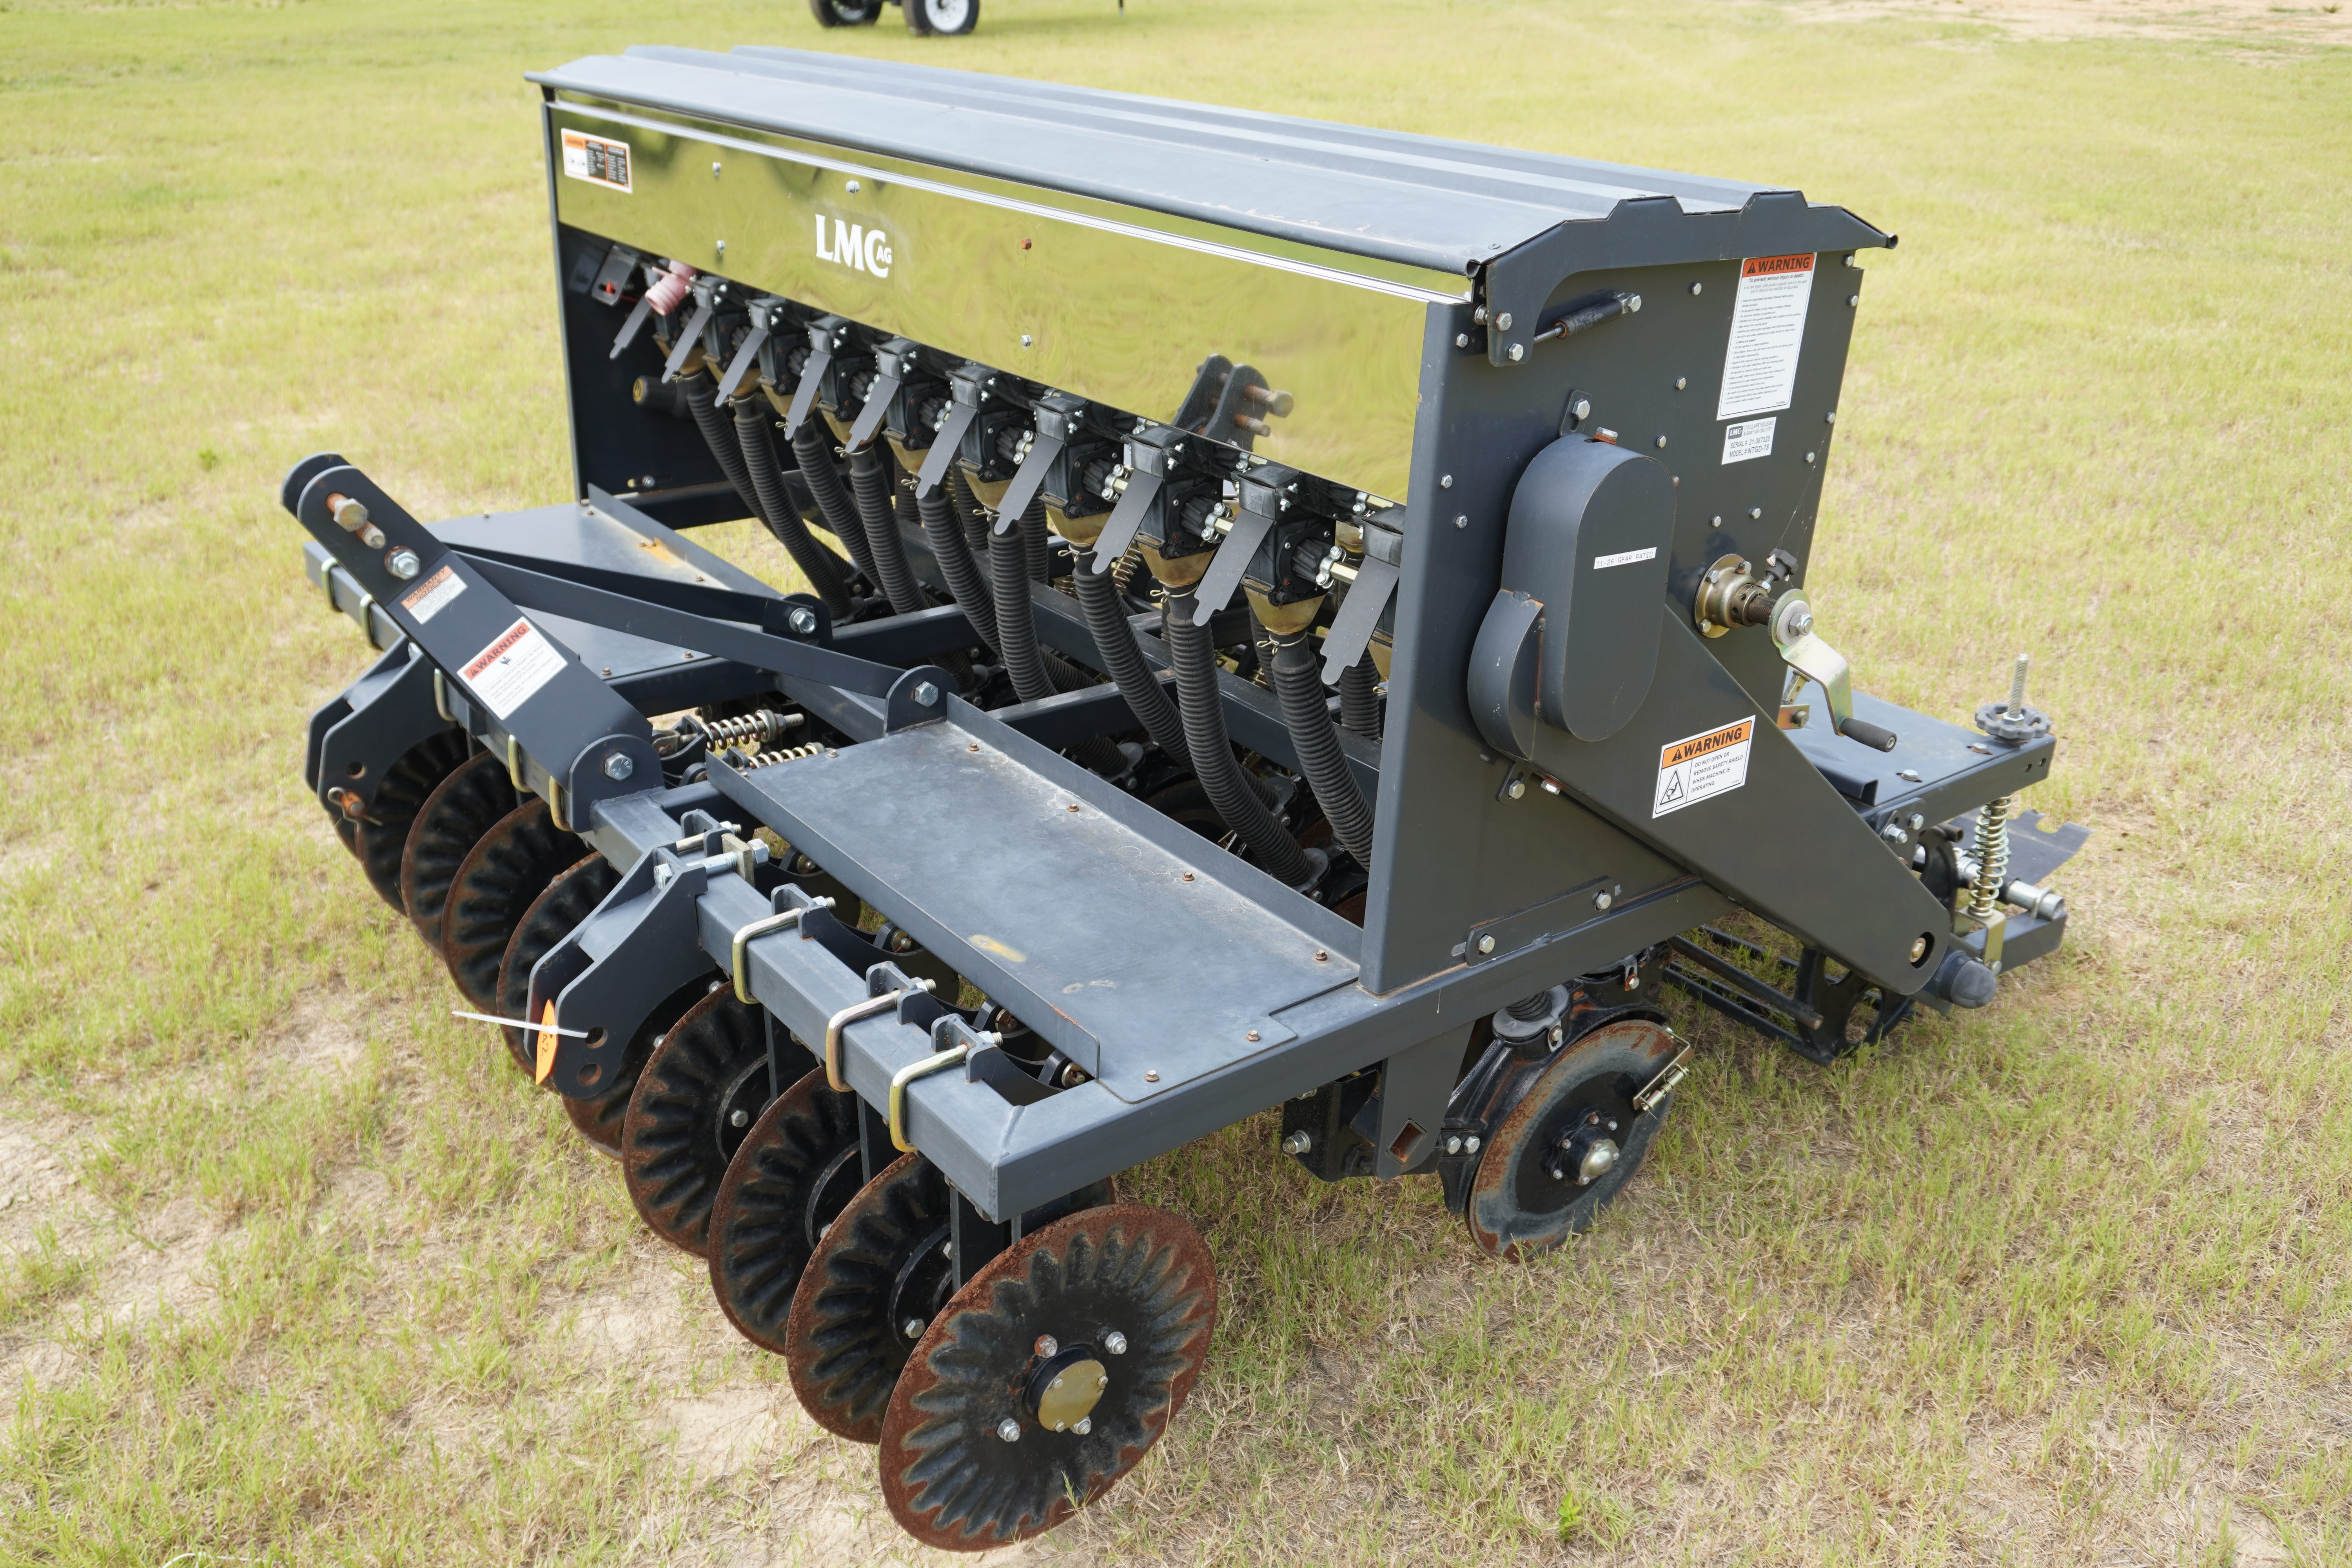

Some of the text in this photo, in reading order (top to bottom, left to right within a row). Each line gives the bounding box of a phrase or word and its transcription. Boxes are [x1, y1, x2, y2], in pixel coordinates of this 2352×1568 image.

[815, 214, 889, 278] LMC
[876, 245, 892, 265] AG
[1759, 257, 1810, 273] WARNING
[1730, 428, 1742, 436] LMC
[1729, 449, 1744, 457] MODEL
[1748, 444, 1769, 454] NTGD-78
[1730, 440, 1744, 448] SERIAL
[1749, 435, 1770, 445] 21-367325
[1596, 551, 1653, 567] 11-26 GEAR RATIO
[406, 568, 445, 602] WARRANTY
[416, 578, 442, 600] NOTICE
[475, 626, 526, 670] WARNING
[1684, 727, 1742, 758] WARNING
[1693, 754, 1743, 776] REMOVE SAFETY SHIELD
[1692, 776, 1705, 784] WHEN
[1706, 769, 1725, 780] MACHINE
[1691, 780, 1716, 793] OPERATING.
